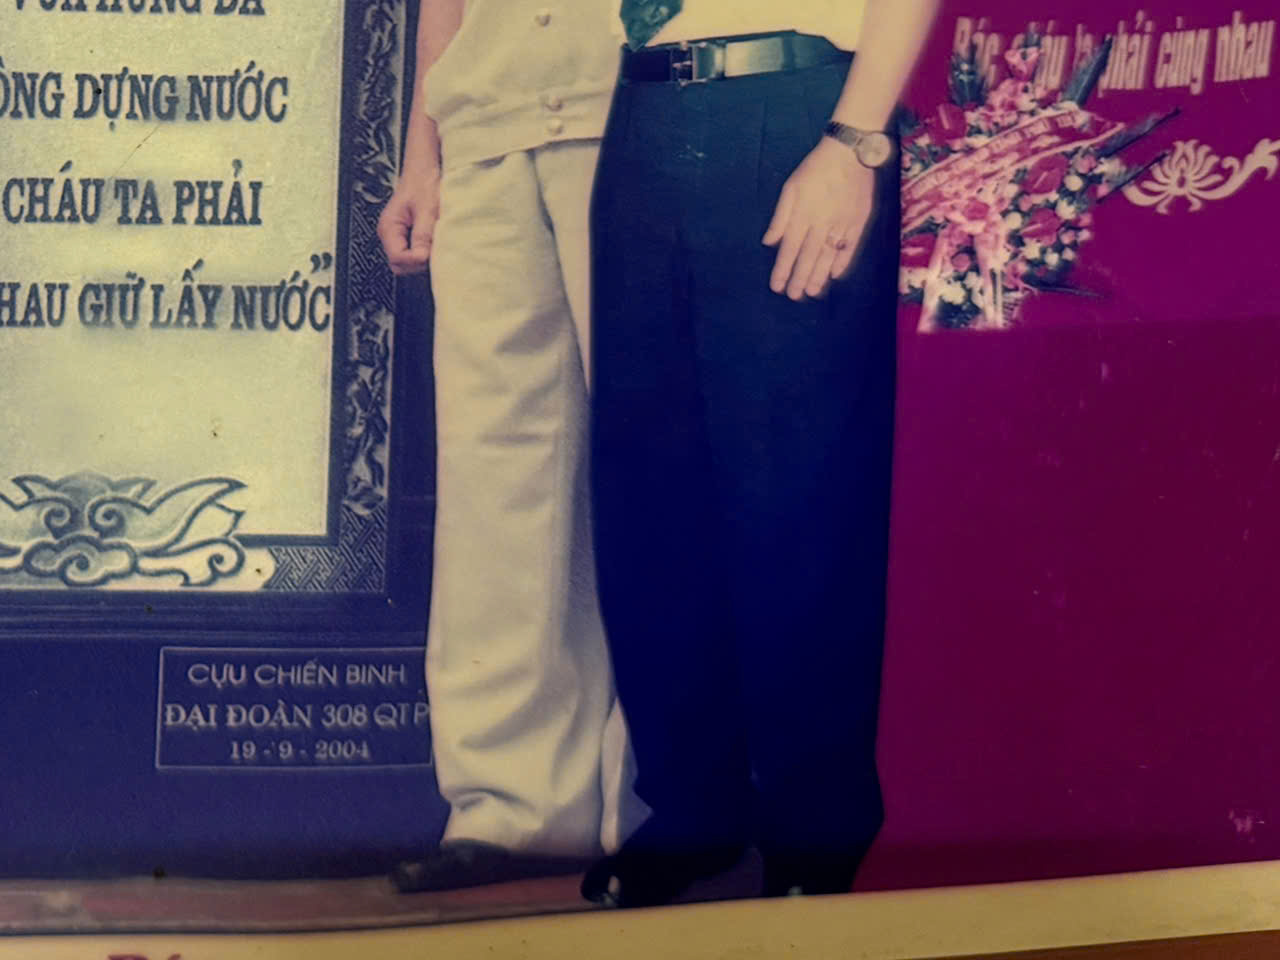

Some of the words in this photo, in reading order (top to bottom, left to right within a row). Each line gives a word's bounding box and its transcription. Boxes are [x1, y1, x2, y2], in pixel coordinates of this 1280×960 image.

[1154, 16, 1210, 95] cùng
[1214, 10, 1276, 83] nhau
[73, 66, 180, 131] DỰNG
[187, 60, 289, 123] NƯỚC
[2, 160, 105, 224] CHÁU
[113, 177, 163, 225] TA
[172, 158, 263, 227] PHẢI
[77, 271, 144, 329] GIỮ
[150, 258, 223, 329] LẤY
[187, 662, 247, 689] CỰU
[254, 657, 338, 685] CHIẾN
[345, 664, 406, 684] BINH
[164, 703, 218, 731] ĐẠI
[225, 699, 313, 727] ĐOÀN
[321, 704, 368, 727] 308
